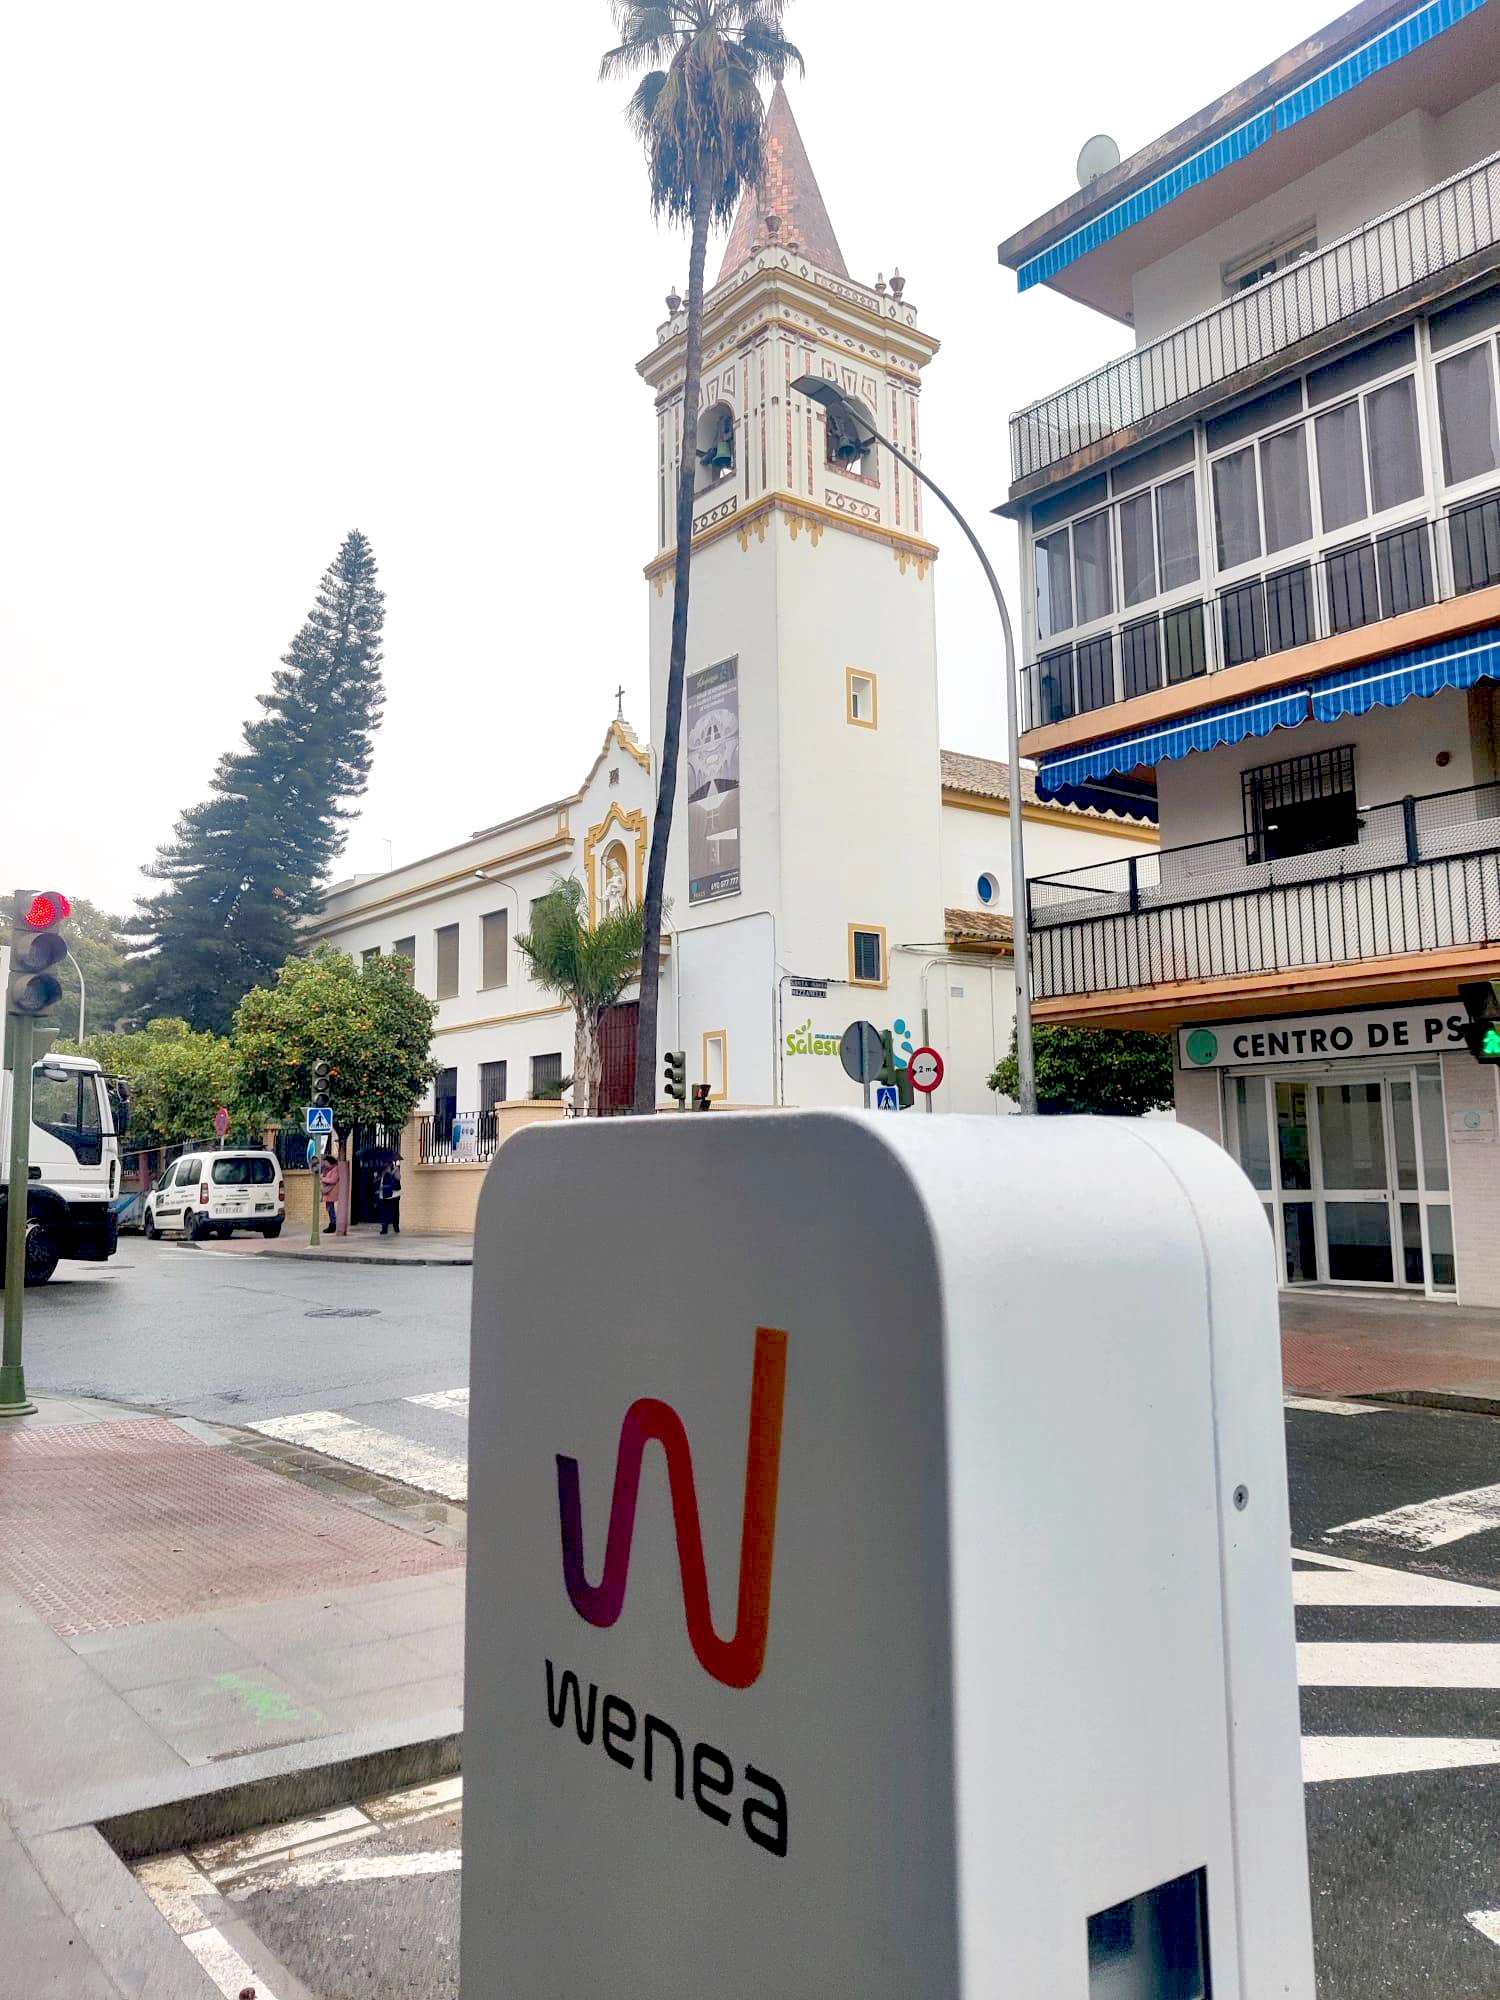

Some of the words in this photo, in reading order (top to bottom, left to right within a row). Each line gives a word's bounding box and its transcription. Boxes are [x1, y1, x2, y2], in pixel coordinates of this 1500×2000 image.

[786, 1033, 841, 1056] Salesi
[1233, 1026, 1353, 1058] CENTRO
[1368, 1021, 1409, 1048] DE
[545, 1658, 788, 1859] wenea
